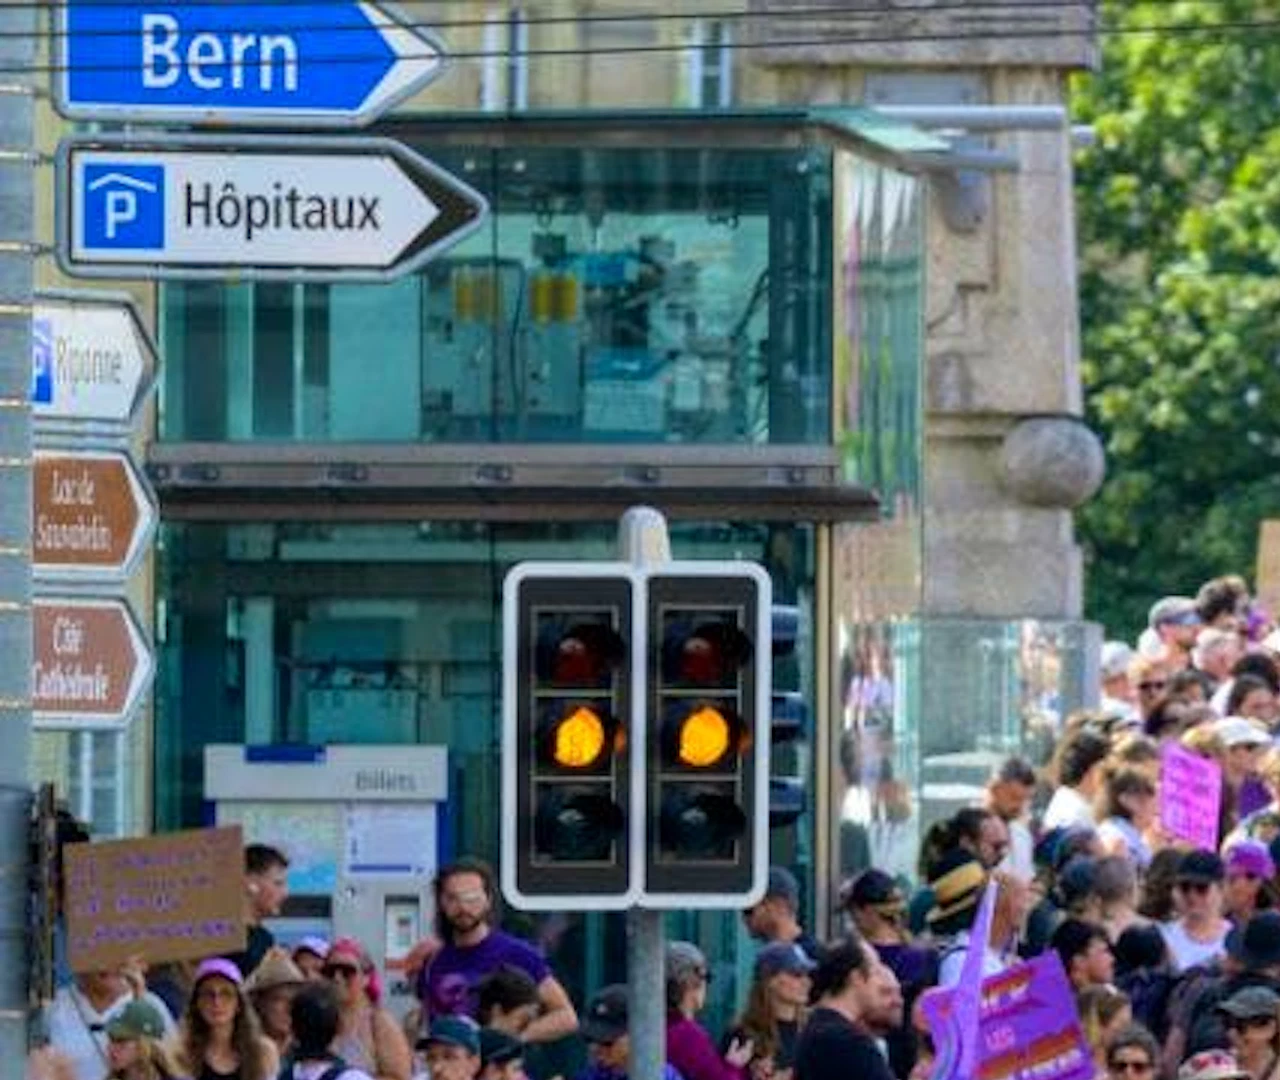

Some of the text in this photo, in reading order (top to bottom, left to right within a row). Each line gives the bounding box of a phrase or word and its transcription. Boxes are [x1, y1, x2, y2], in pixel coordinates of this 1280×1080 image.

[142, 14, 298, 90] Bern
[184, 182, 381, 240] Hôpitaux
[356, 769, 417, 791] Billets
